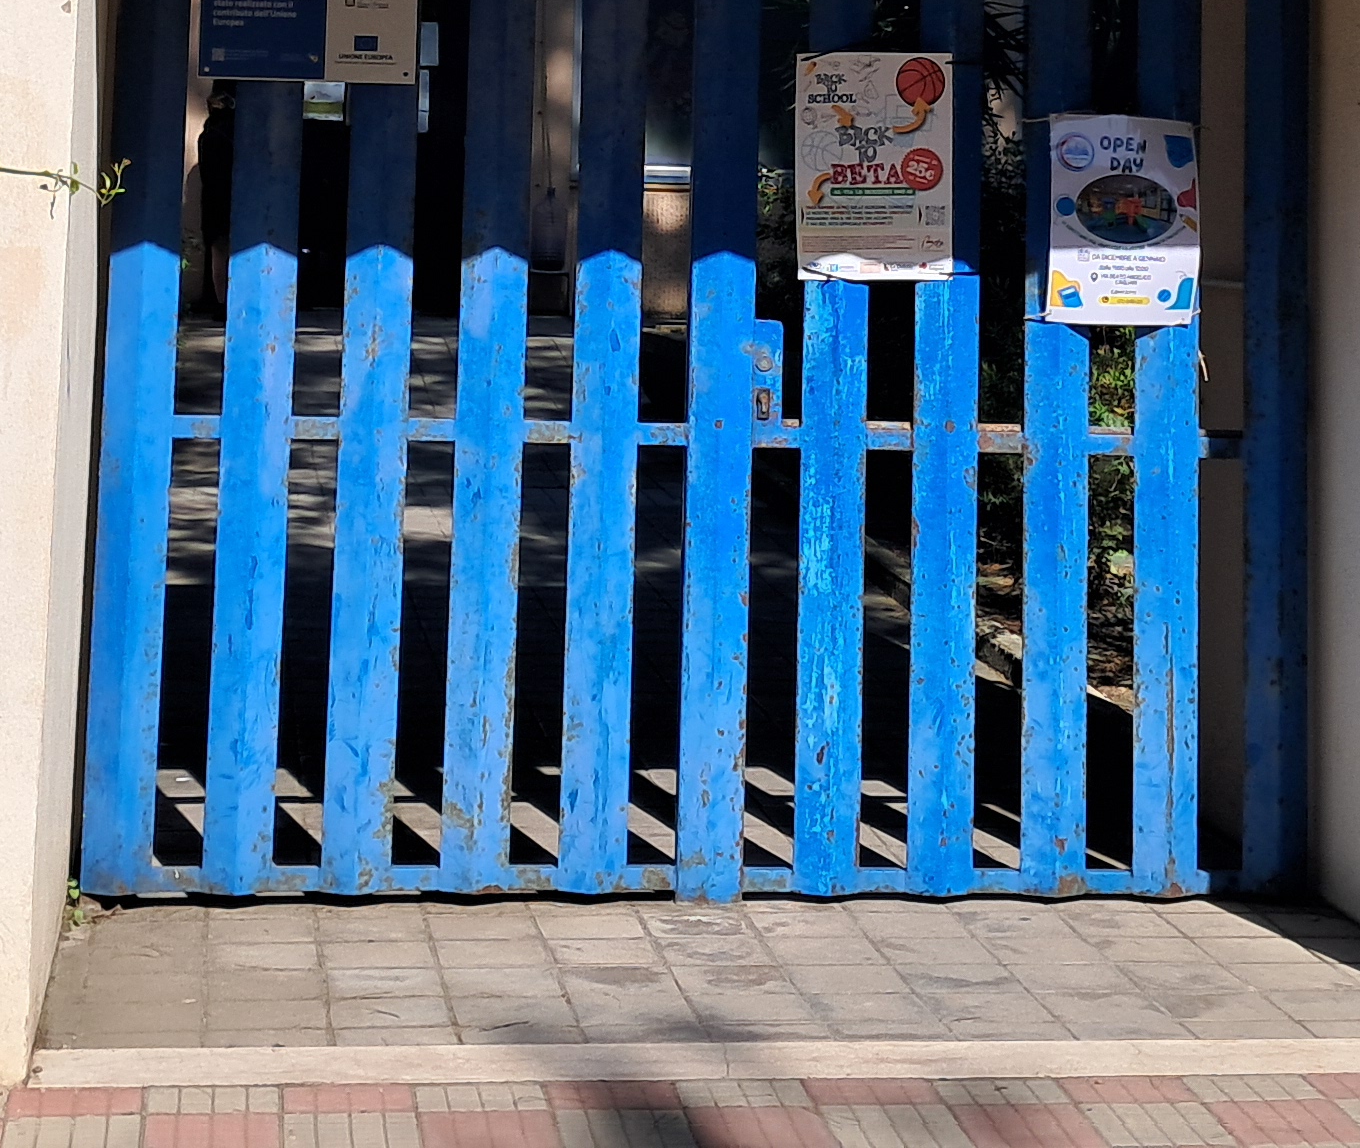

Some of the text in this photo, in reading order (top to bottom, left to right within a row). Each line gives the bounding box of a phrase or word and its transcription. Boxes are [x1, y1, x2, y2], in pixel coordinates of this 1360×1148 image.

[213, 0, 234, 7] stato
[235, 0, 272, 8] realizzato
[213, 8, 253, 17] contributo
[213, 18, 244, 27] Europea
[815, 73, 847, 85] BACK
[824, 82, 838, 94] TO
[807, 93, 857, 104] SCHOOL
[835, 125, 895, 147] BACK
[1099, 135, 1147, 155] OPEN
[855, 145, 878, 163] TO
[1109, 156, 1144, 173] DAY
[830, 163, 904, 185] BETA
